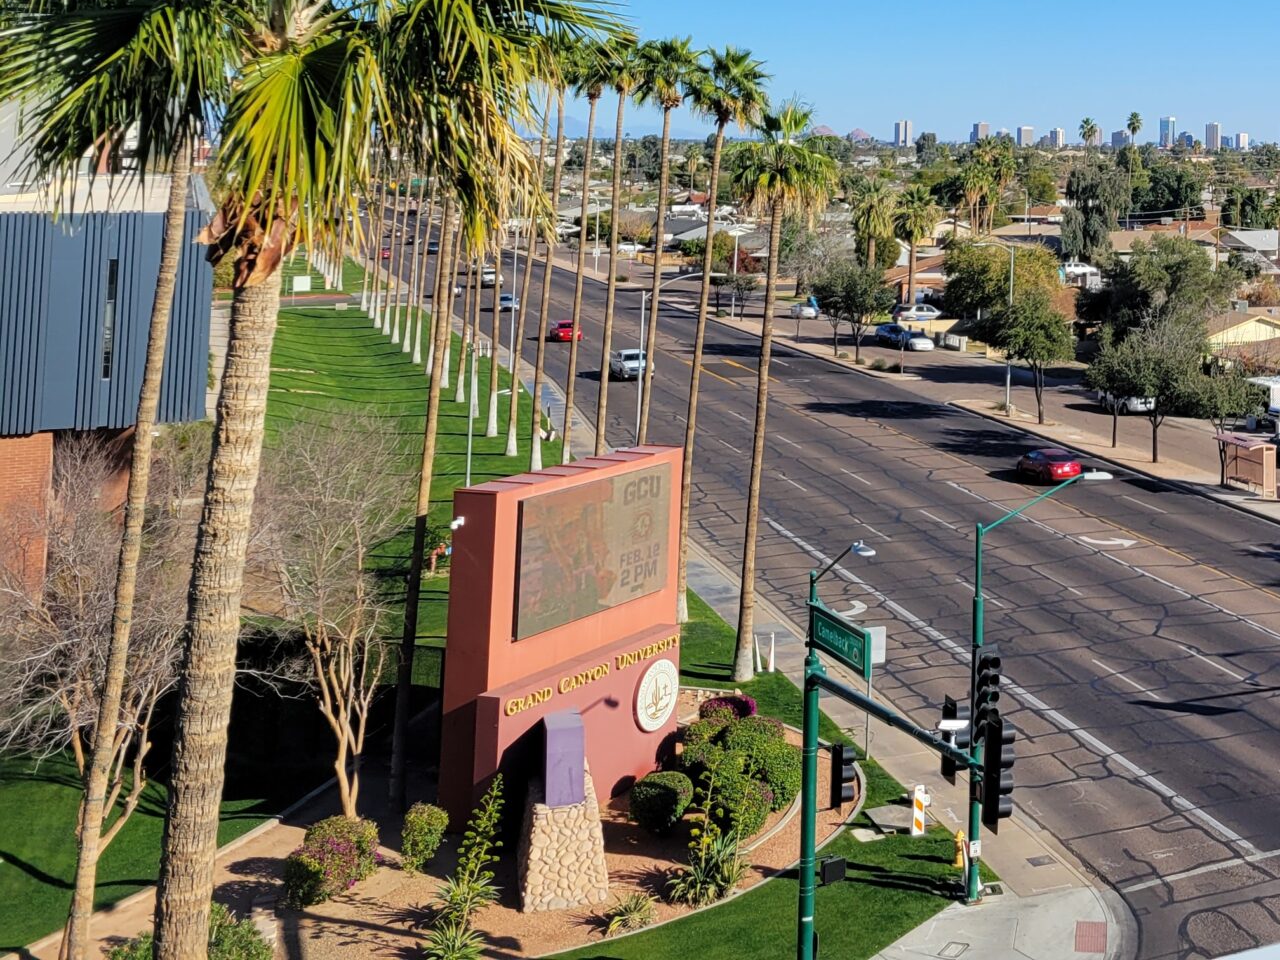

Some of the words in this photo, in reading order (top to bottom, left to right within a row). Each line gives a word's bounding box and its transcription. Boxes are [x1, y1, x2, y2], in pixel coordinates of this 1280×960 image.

[623, 475, 661, 506] GCU
[620, 549, 644, 569] FEB.
[620, 569, 631, 587] 2
[634, 559, 657, 582] PM
[505, 687, 553, 716] GRAND
[558, 662, 610, 694] CANYON
[611, 632, 680, 670] UNIVERSITY
